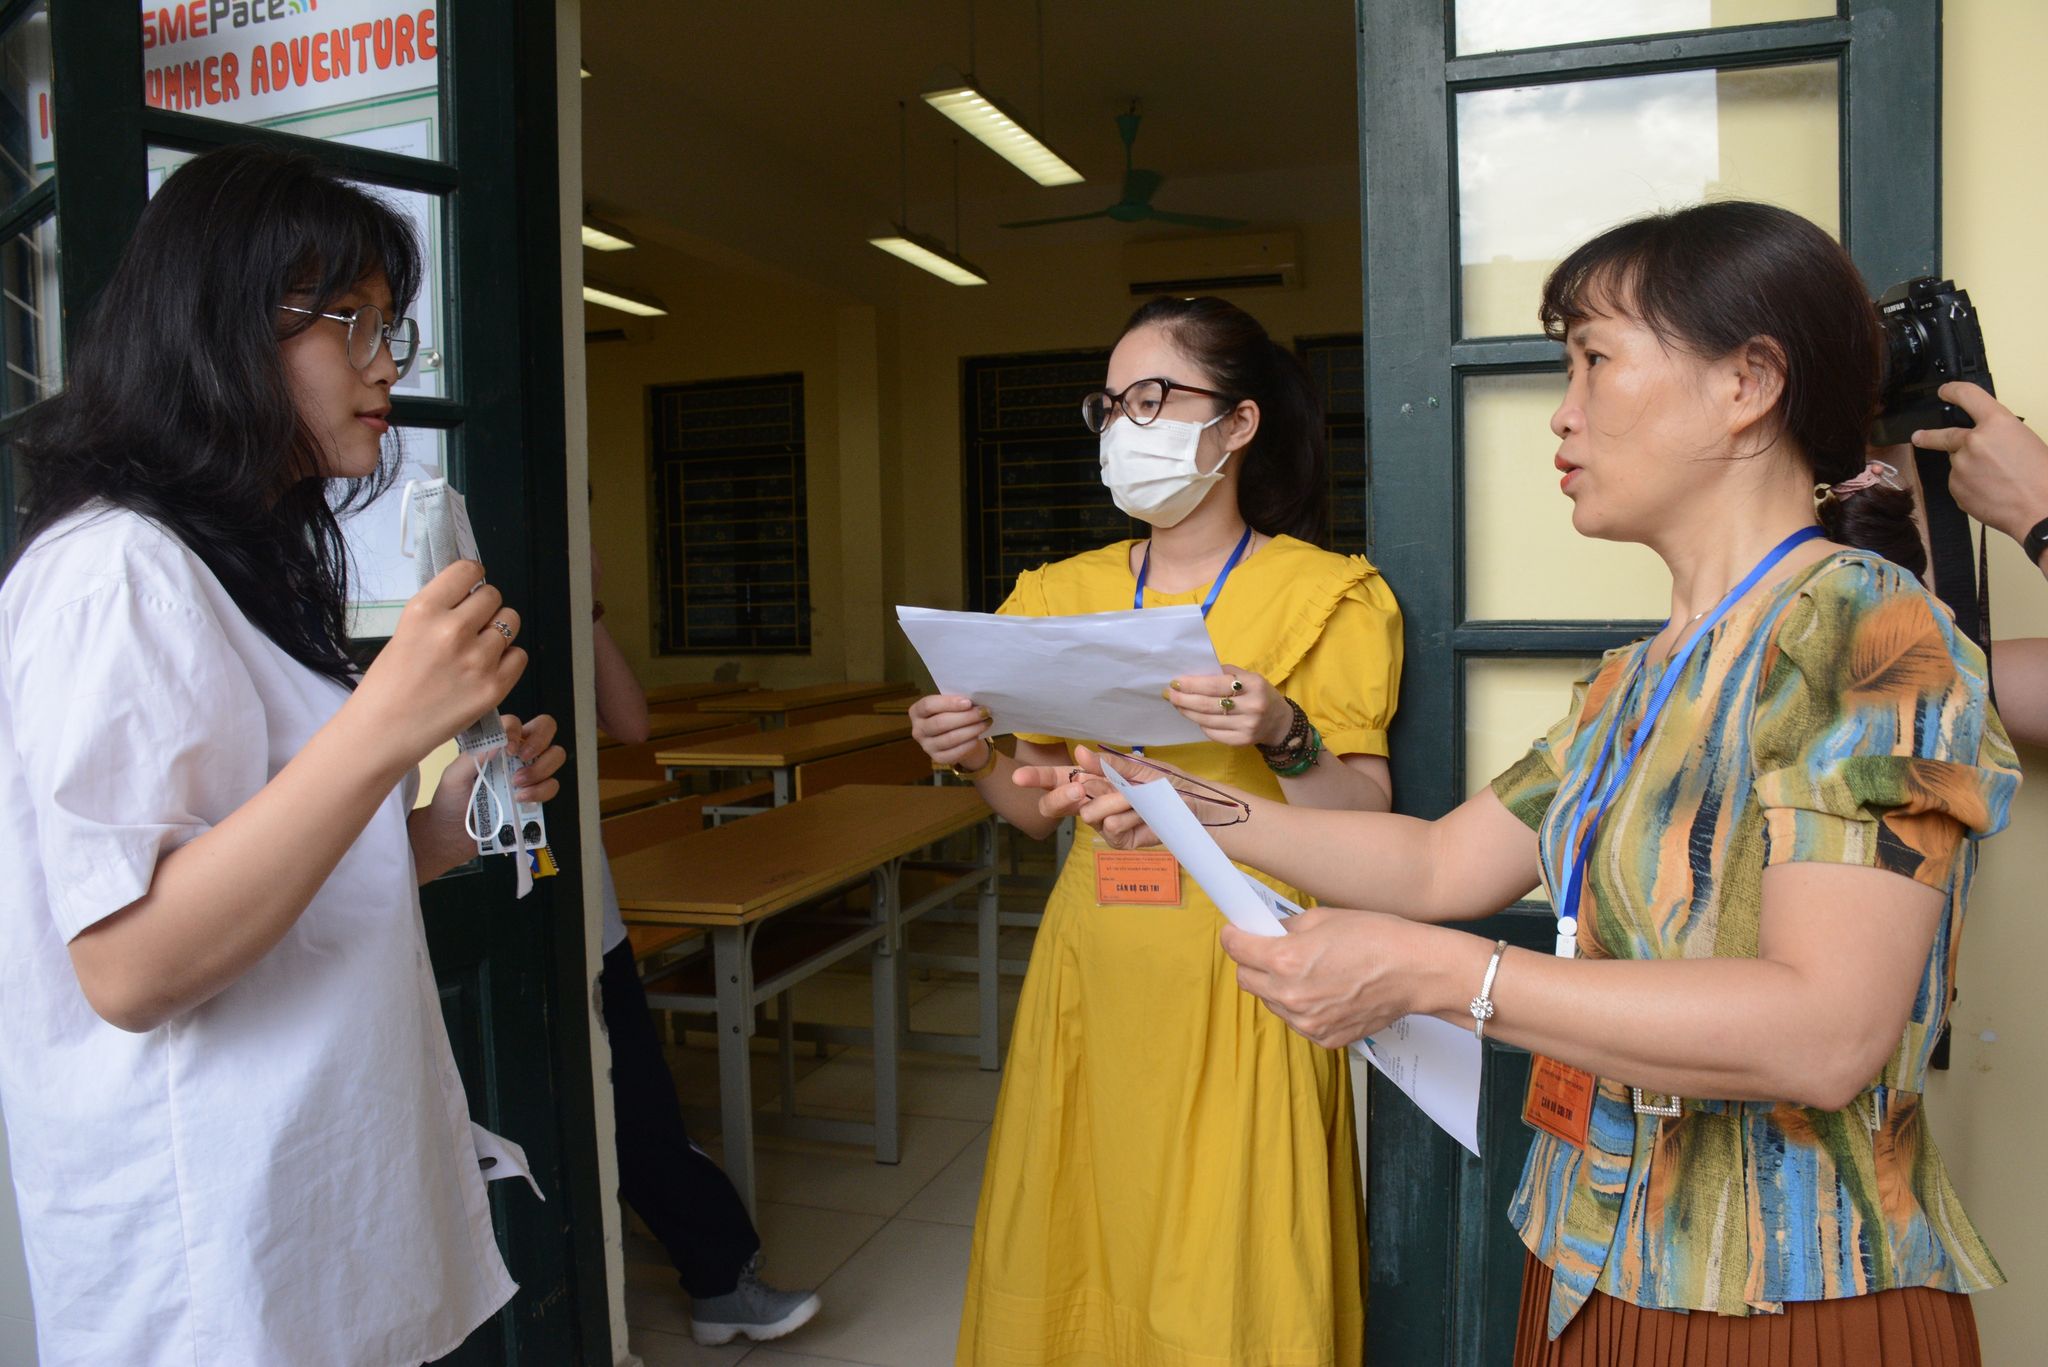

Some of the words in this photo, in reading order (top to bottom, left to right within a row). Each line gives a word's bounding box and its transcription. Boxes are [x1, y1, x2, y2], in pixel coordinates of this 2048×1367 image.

[145, 52, 240, 111] UMMER
[251, 9, 438, 96] ADVENTURE
[1883, 302, 1906, 314] FUJIFILM
